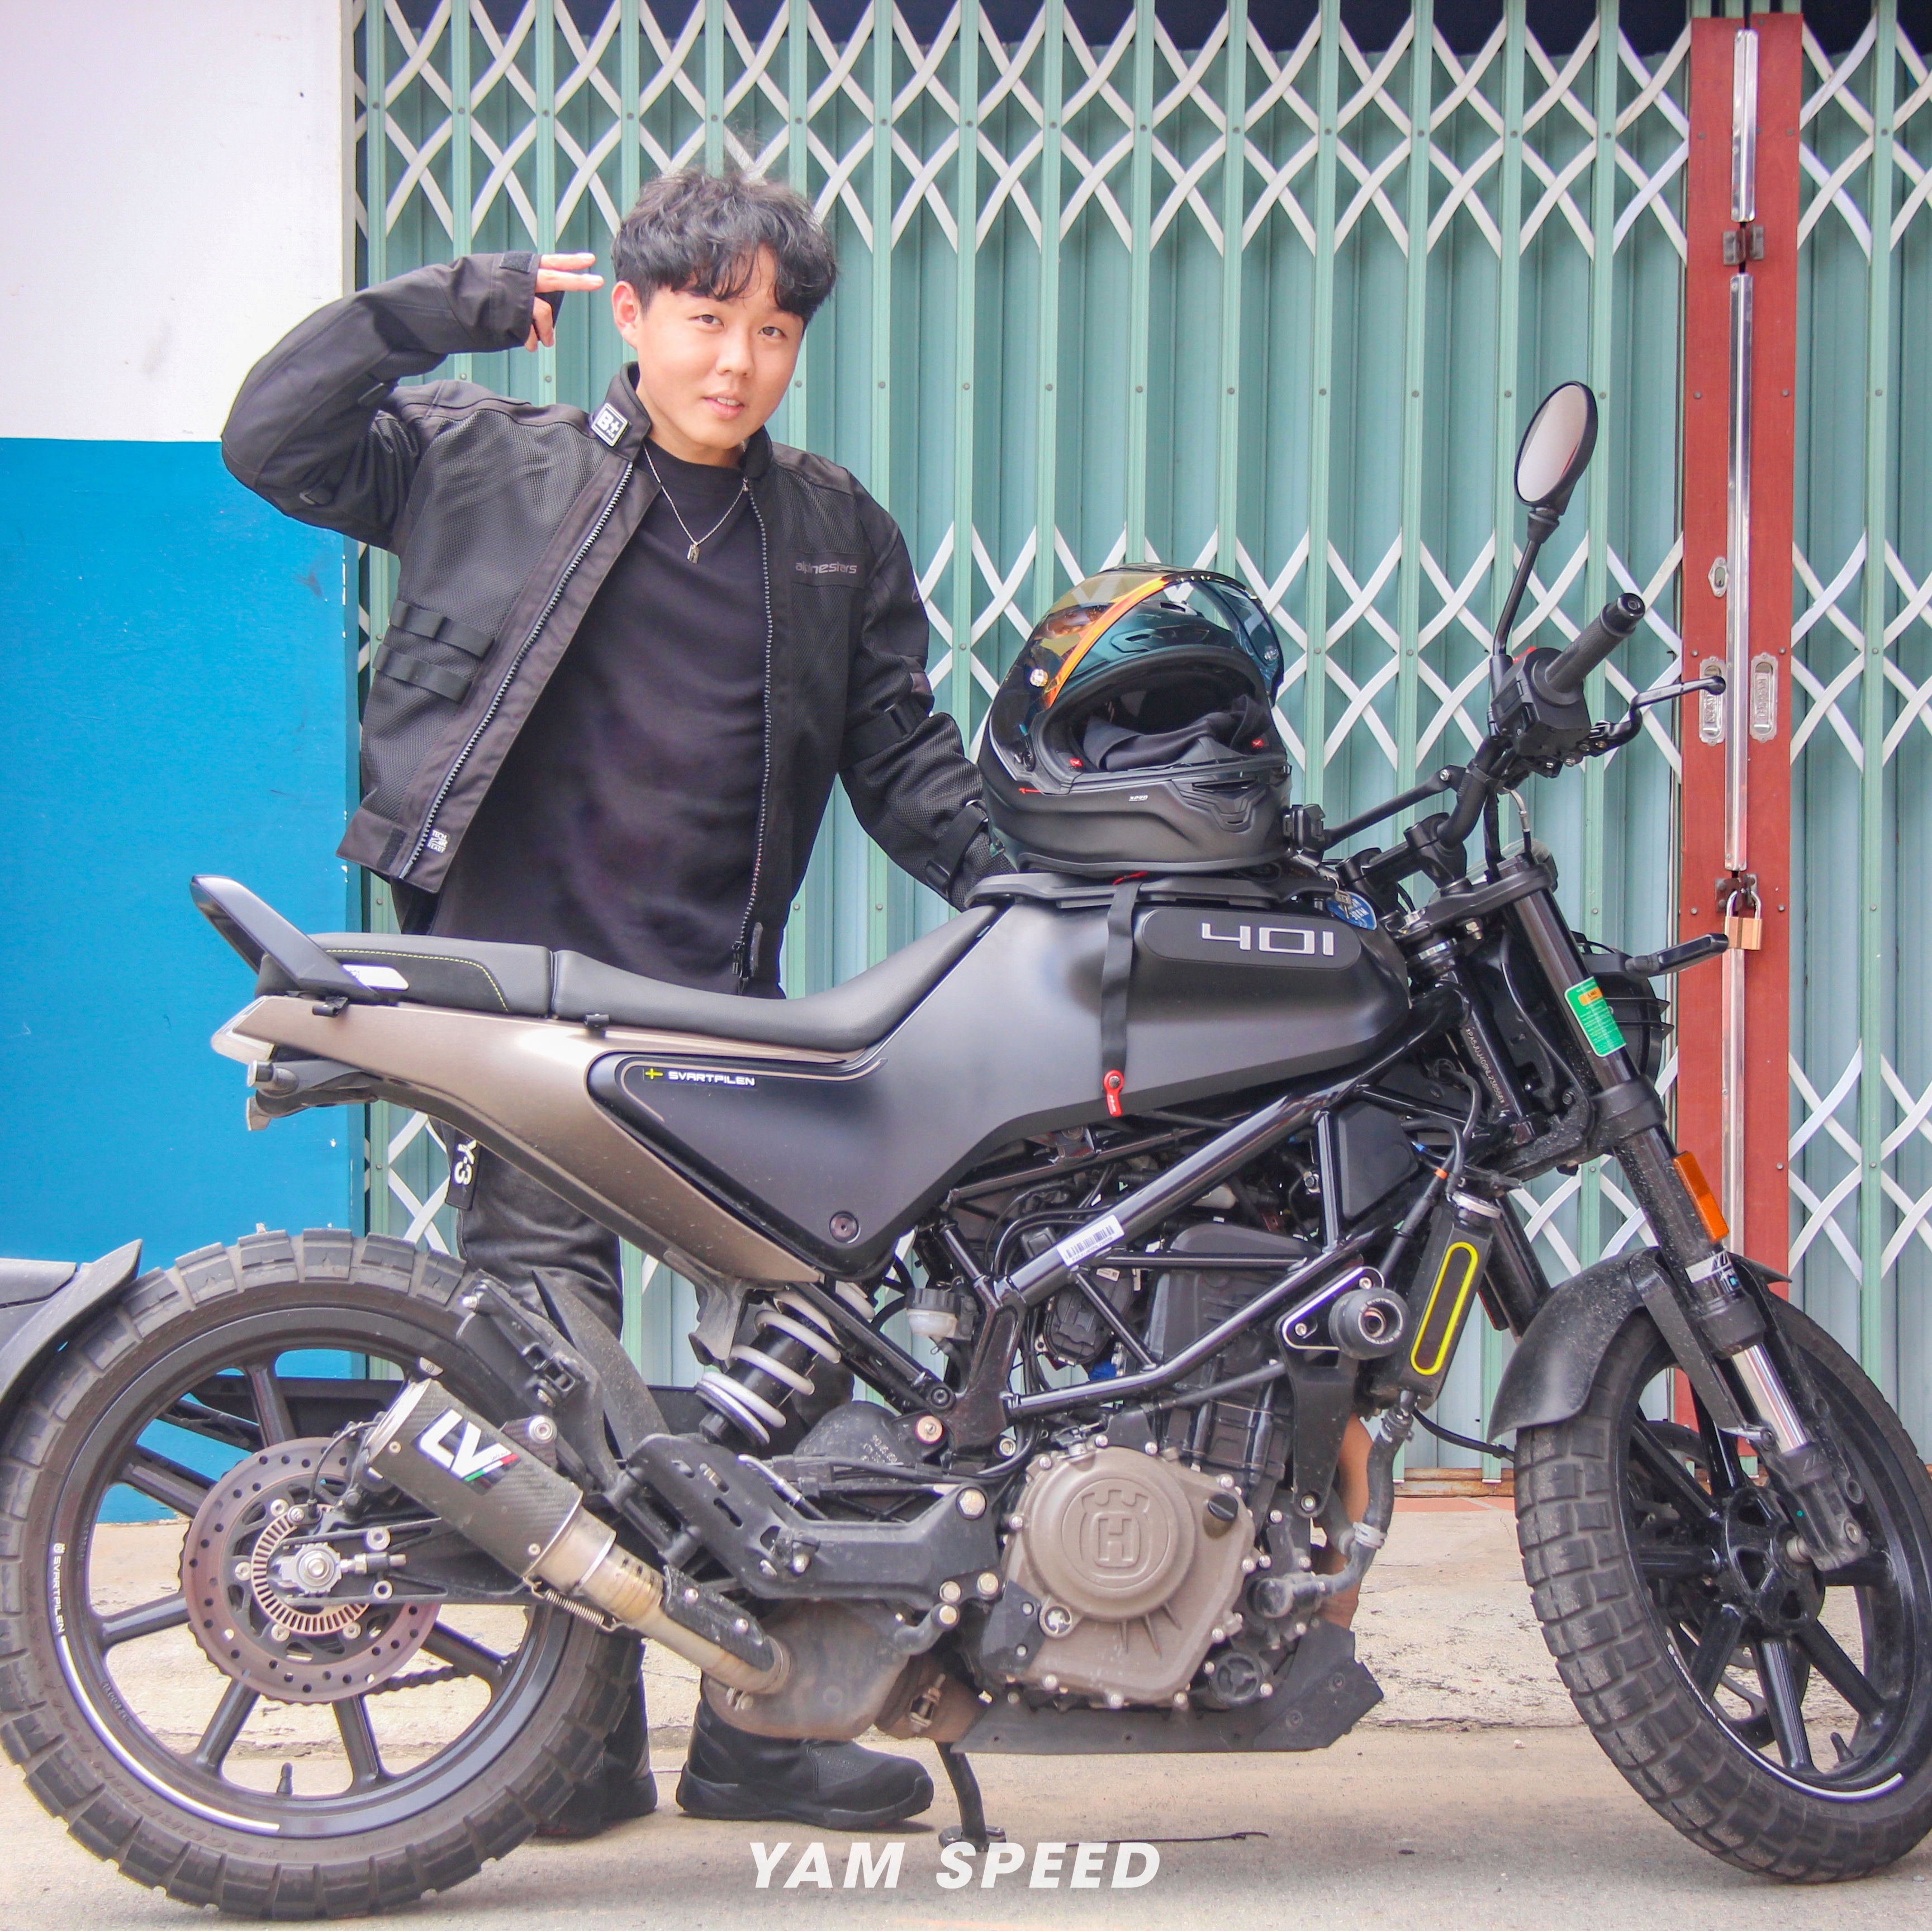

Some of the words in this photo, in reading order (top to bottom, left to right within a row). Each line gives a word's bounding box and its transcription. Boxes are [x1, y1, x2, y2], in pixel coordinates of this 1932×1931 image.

[795, 560, 858, 574] alpinestars
[1201, 922, 1335, 957] 401
[668, 1071, 756, 1087] SVARTPILEN
[454, 1139, 478, 1186] Y-3
[419, 1409, 512, 1478] LV
[53, 1556, 65, 1633] SVARTPILEN
